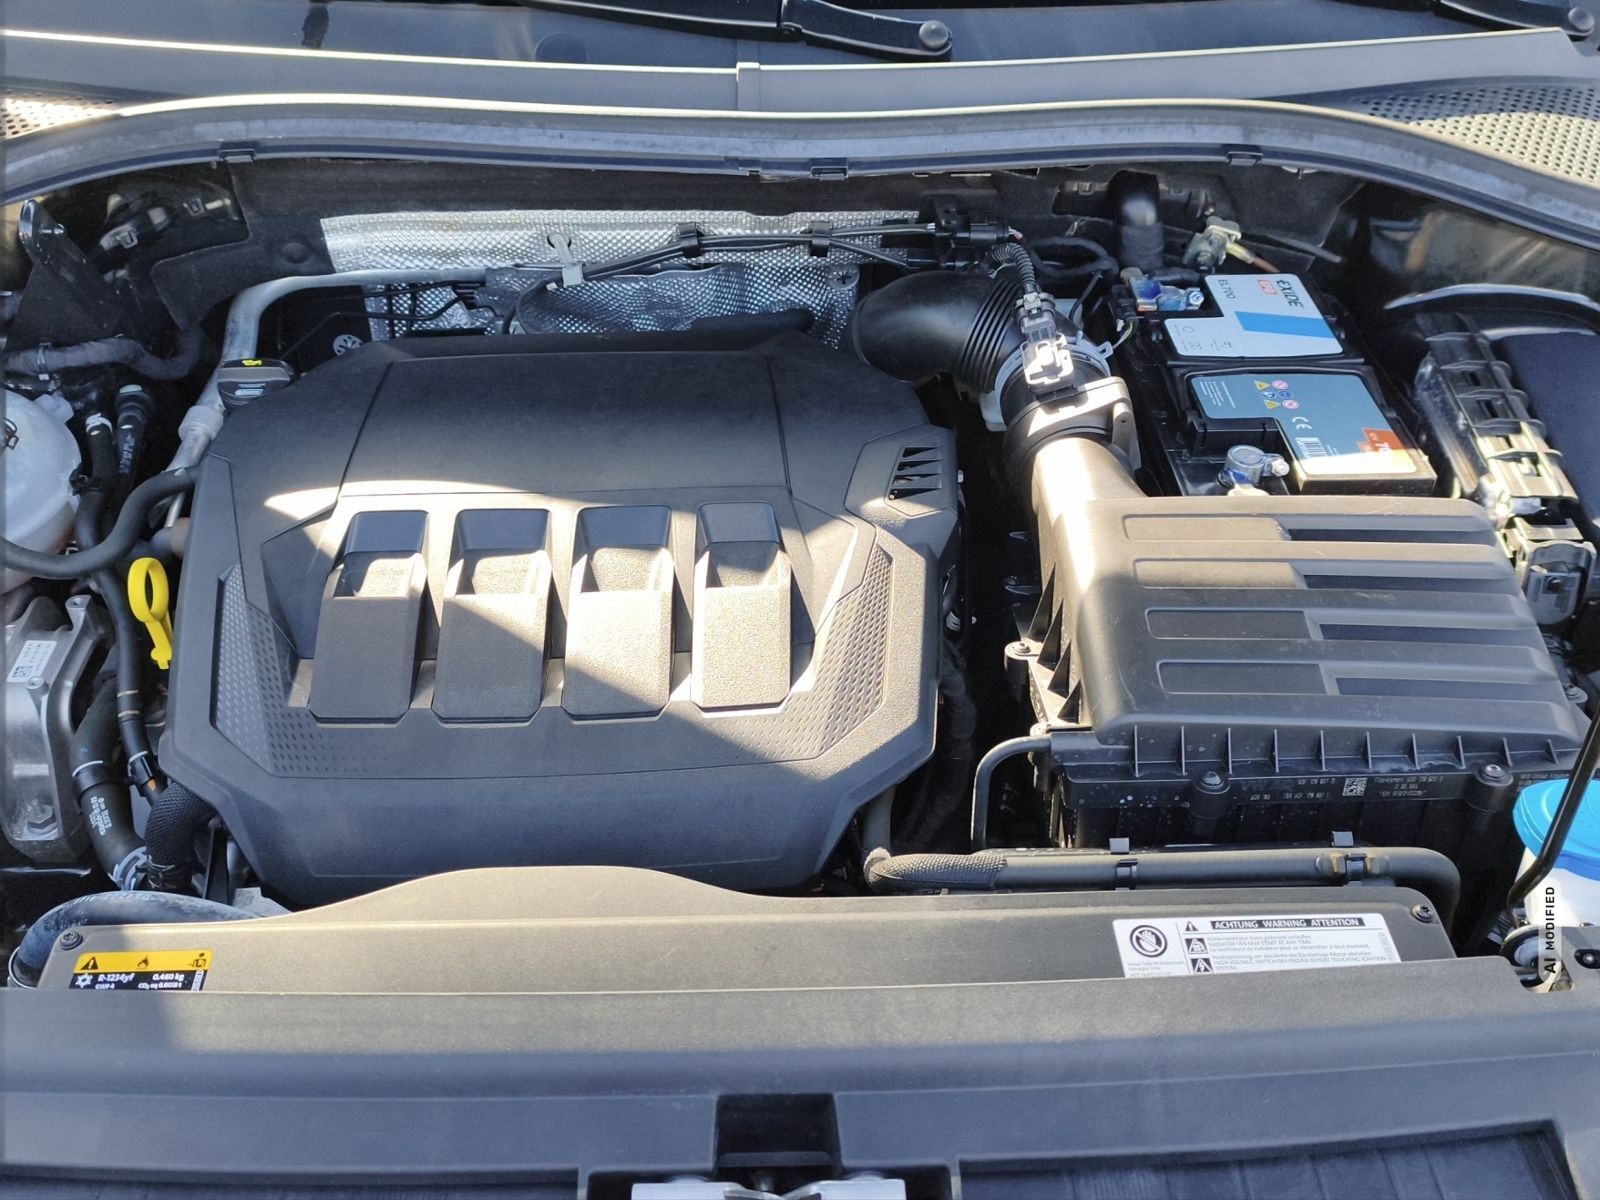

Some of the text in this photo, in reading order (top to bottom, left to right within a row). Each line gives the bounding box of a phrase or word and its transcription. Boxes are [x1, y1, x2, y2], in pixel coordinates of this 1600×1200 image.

[1276, 279, 1304, 309] EXIDE
[1214, 918, 1360, 929] ACHTUNG WARNING ATTENTION
[97, 973, 136, 983] R-1234yf
[174, 973, 185, 982] kg
